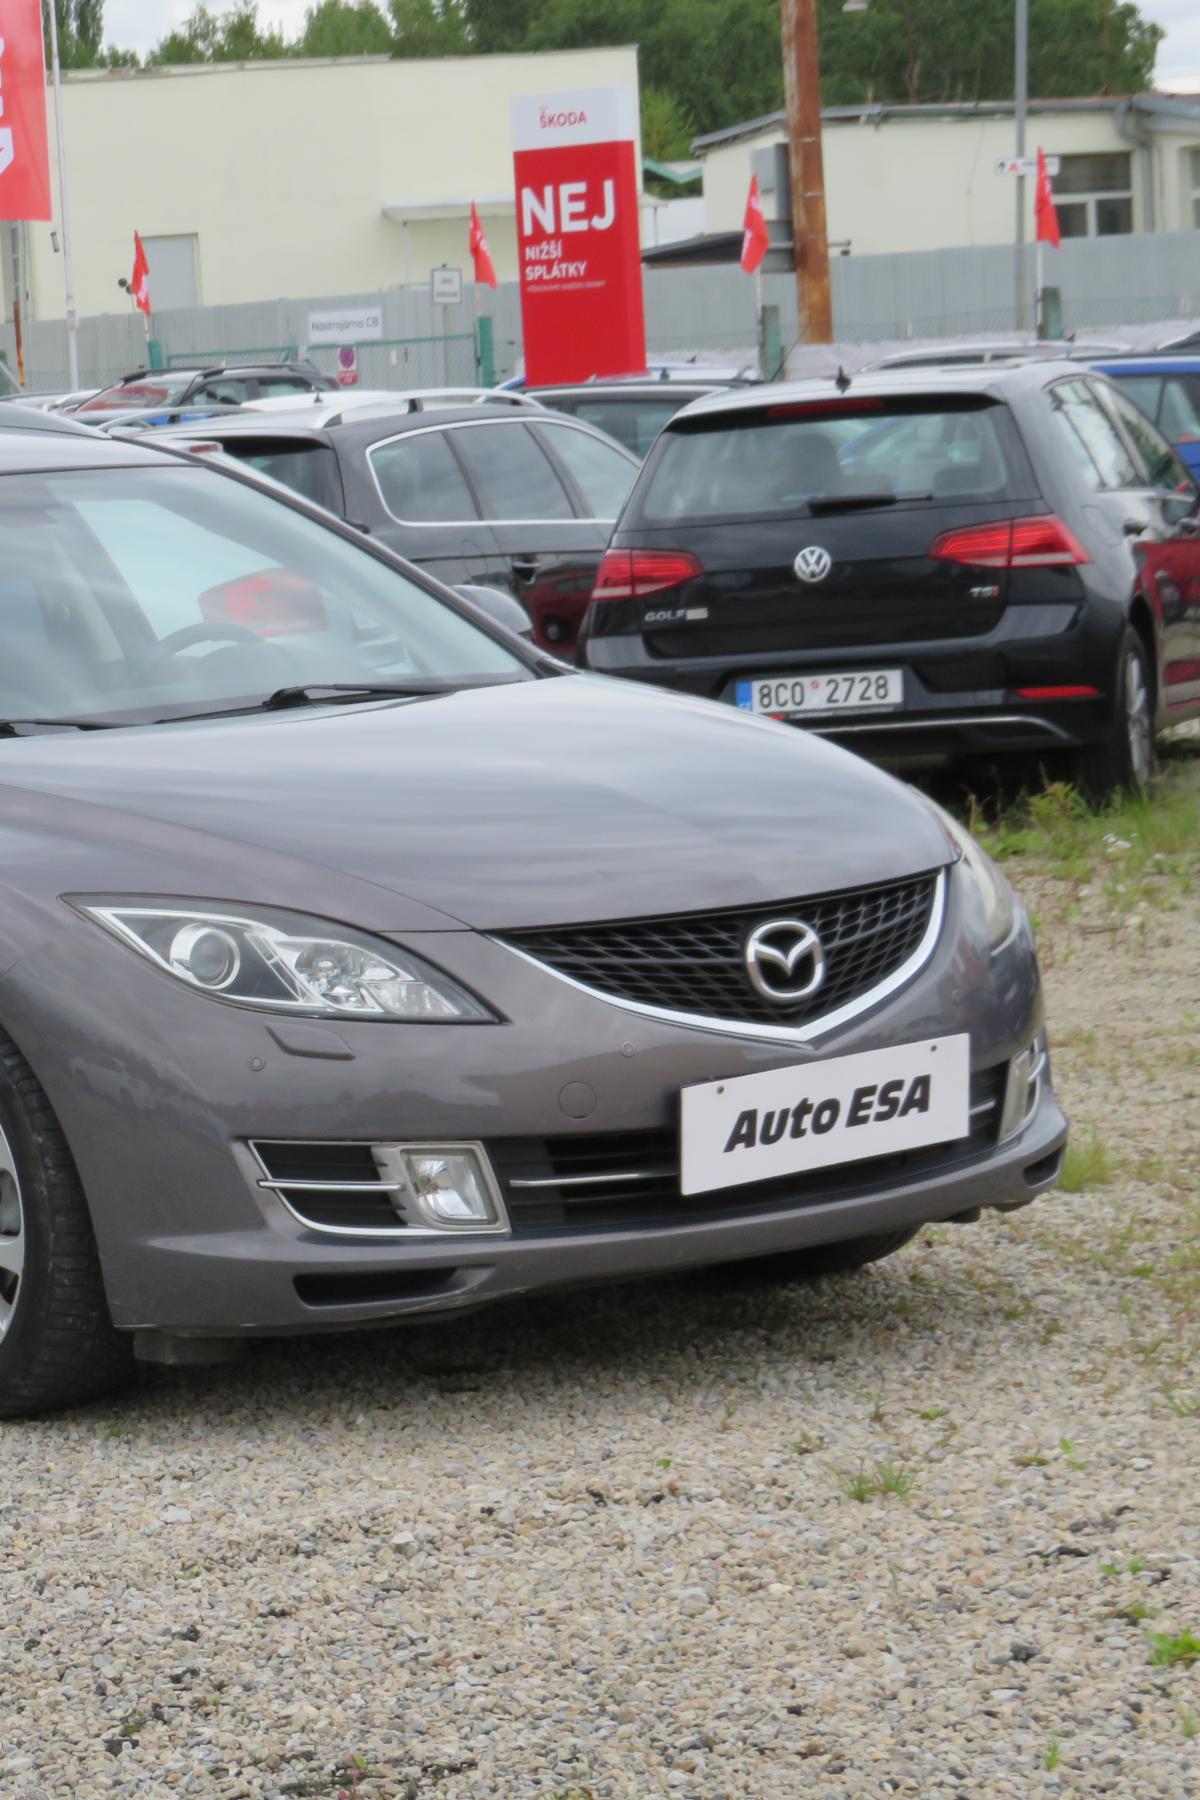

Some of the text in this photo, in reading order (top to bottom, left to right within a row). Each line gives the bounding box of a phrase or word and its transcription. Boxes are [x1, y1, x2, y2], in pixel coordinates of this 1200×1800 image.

[539, 110, 587, 129] ŠKODA
[521, 179, 616, 237] NEJ
[525, 239, 562, 261] NIŽŠÍ
[525, 259, 588, 281] SPLÁTKY
[644, 609, 686, 622] GOLF
[825, 674, 889, 704] 2728
[722, 1074, 932, 1153] Auto ESA
